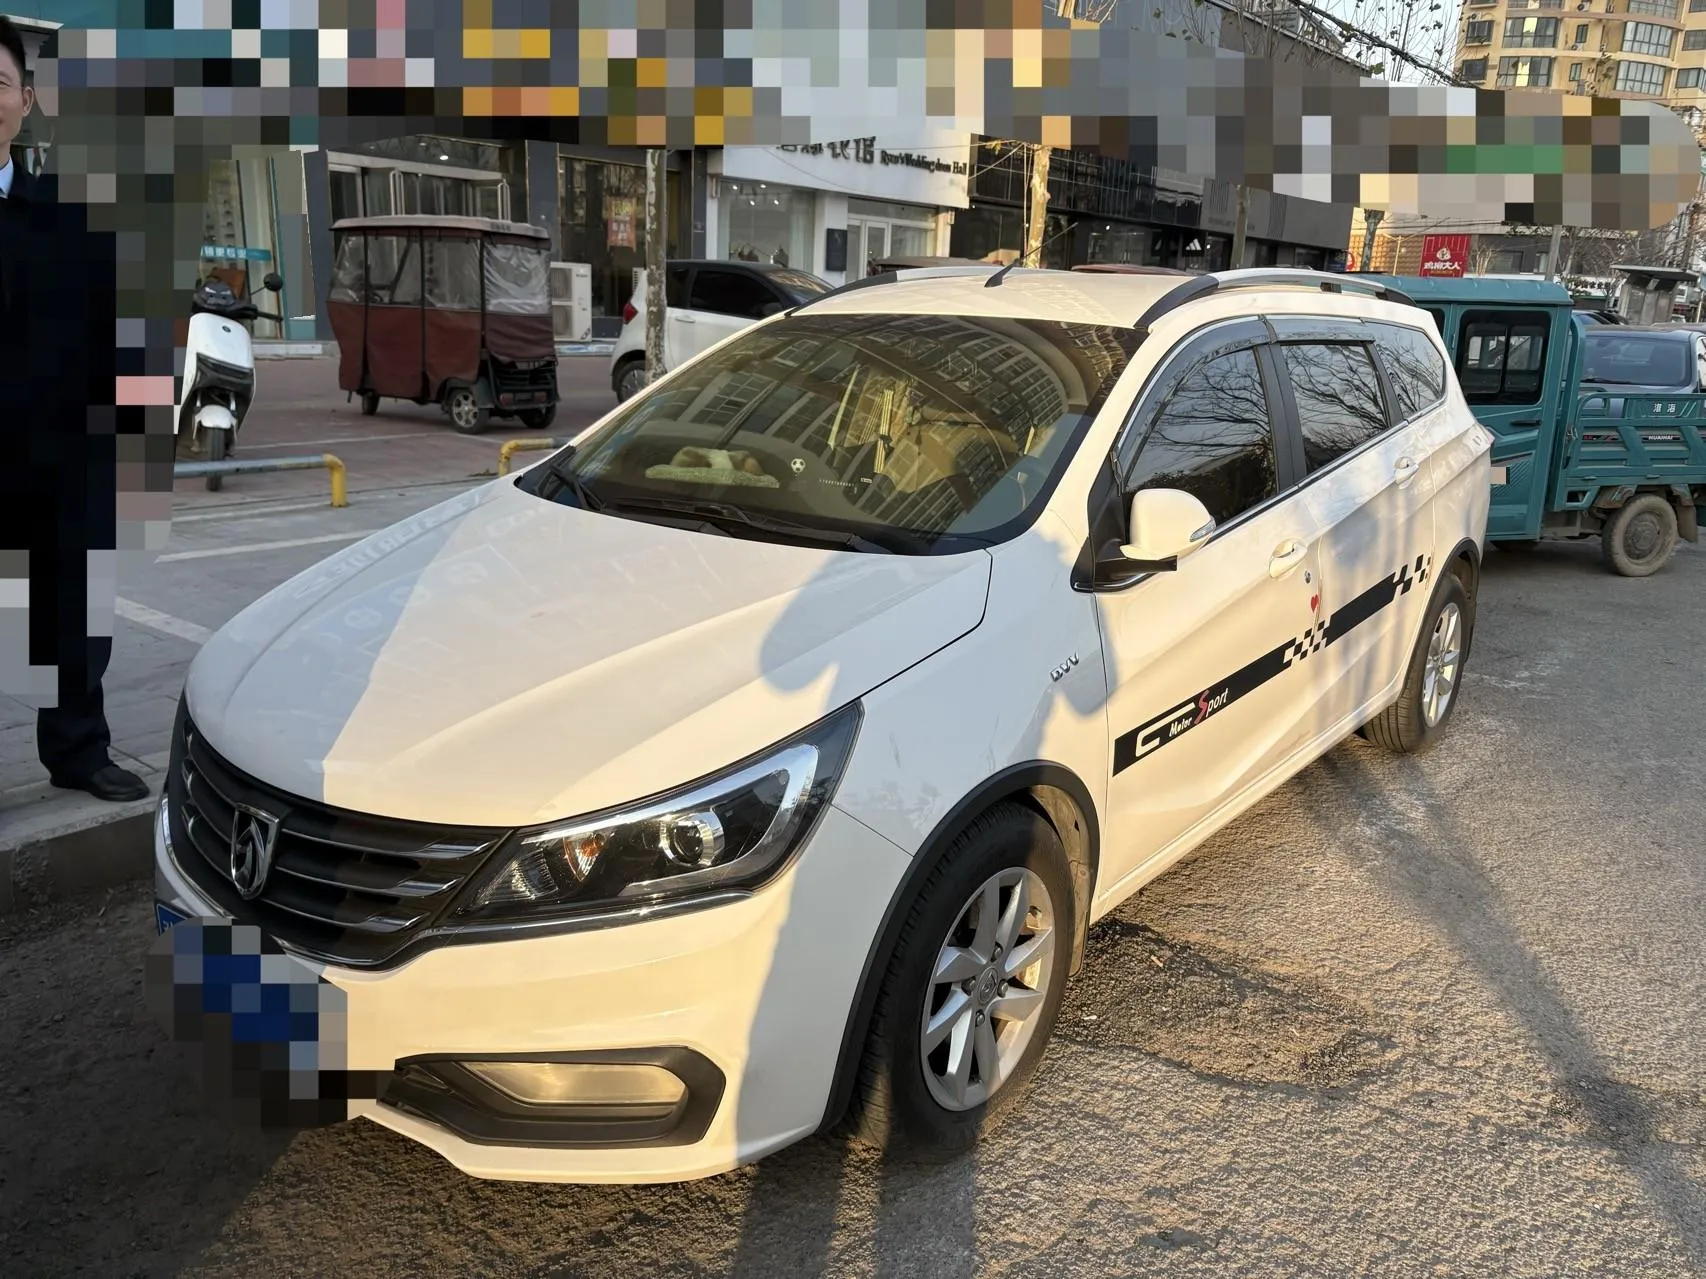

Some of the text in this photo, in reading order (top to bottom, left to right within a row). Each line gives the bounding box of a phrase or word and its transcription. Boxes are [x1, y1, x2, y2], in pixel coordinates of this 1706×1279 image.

[952, 161, 967, 175] Hall
[1168, 717, 1193, 738] Motor
[1194, 688, 1229, 725] Sport
